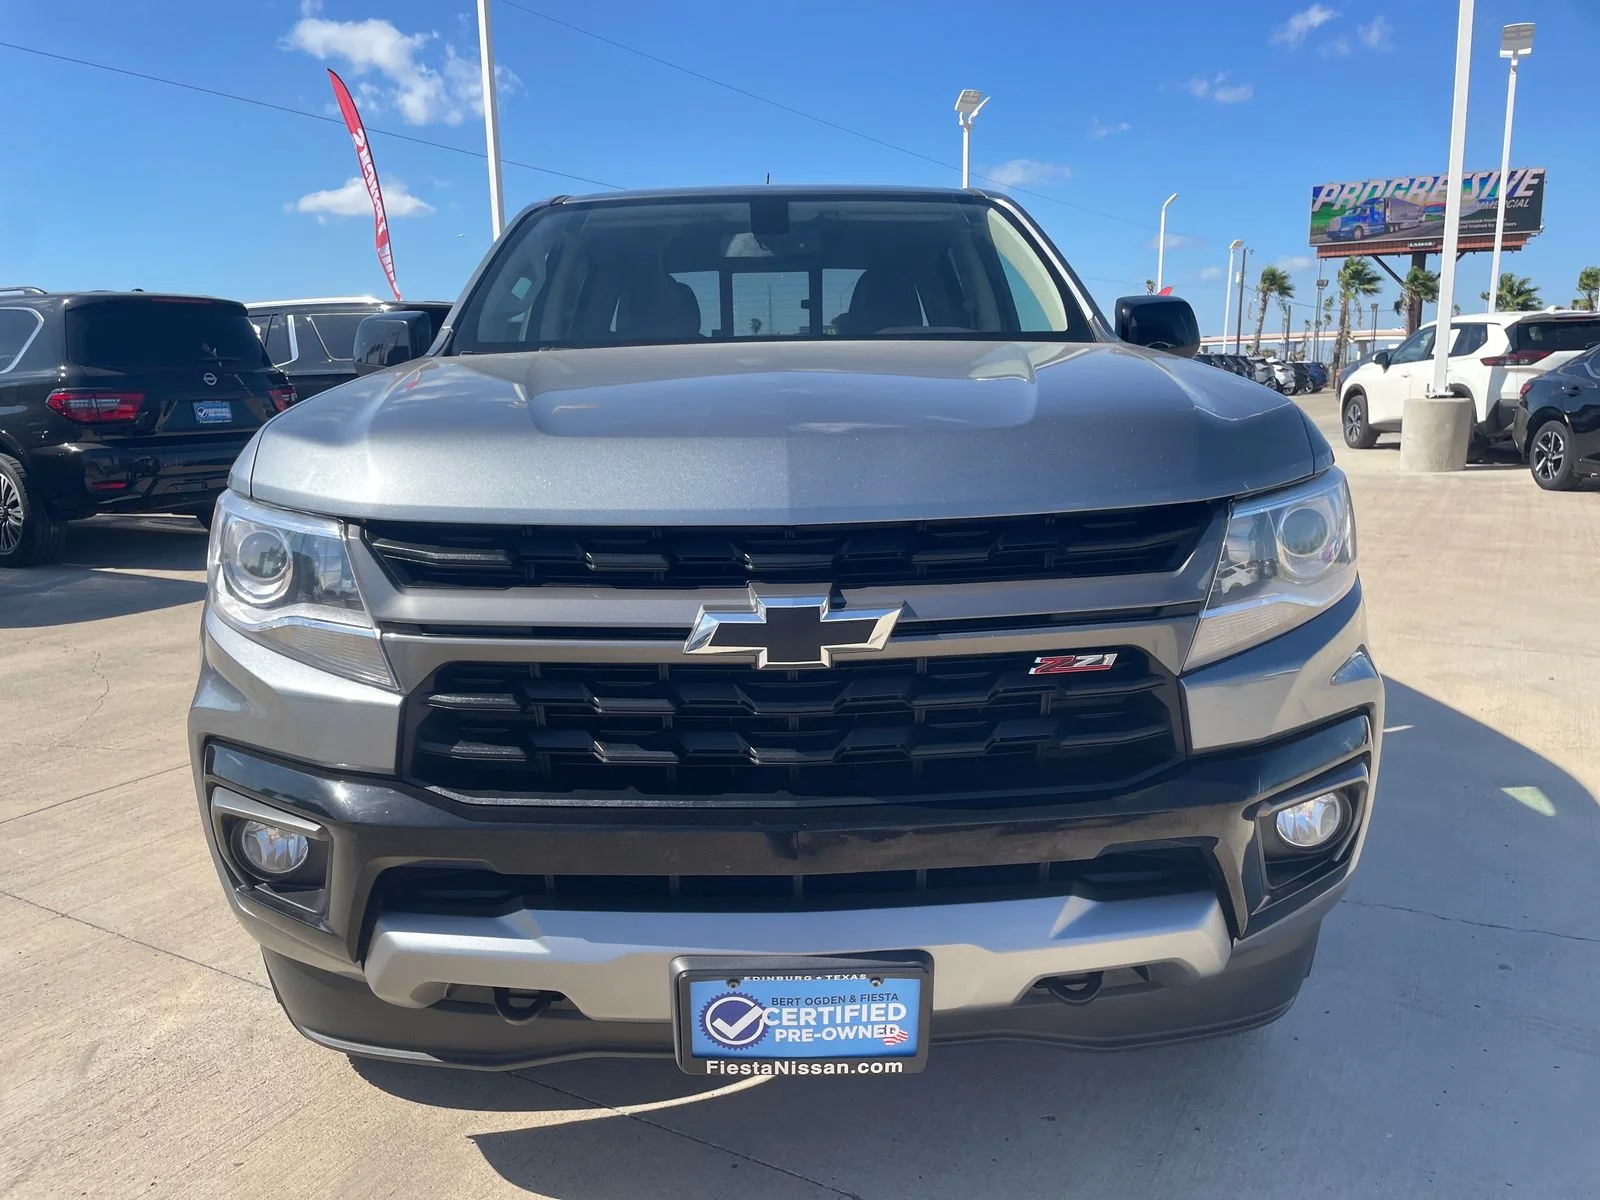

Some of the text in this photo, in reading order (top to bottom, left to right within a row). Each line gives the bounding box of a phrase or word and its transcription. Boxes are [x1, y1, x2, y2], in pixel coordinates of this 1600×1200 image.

[1029, 653, 1118, 675] Z71
[771, 993, 899, 1006] BERT OGDEN & FIESTA
[763, 1003, 907, 1026] CERTIFIED
[775, 1024, 899, 1043] PRE-OWNED
[706, 1060, 903, 1075] FiestaNissan.com
